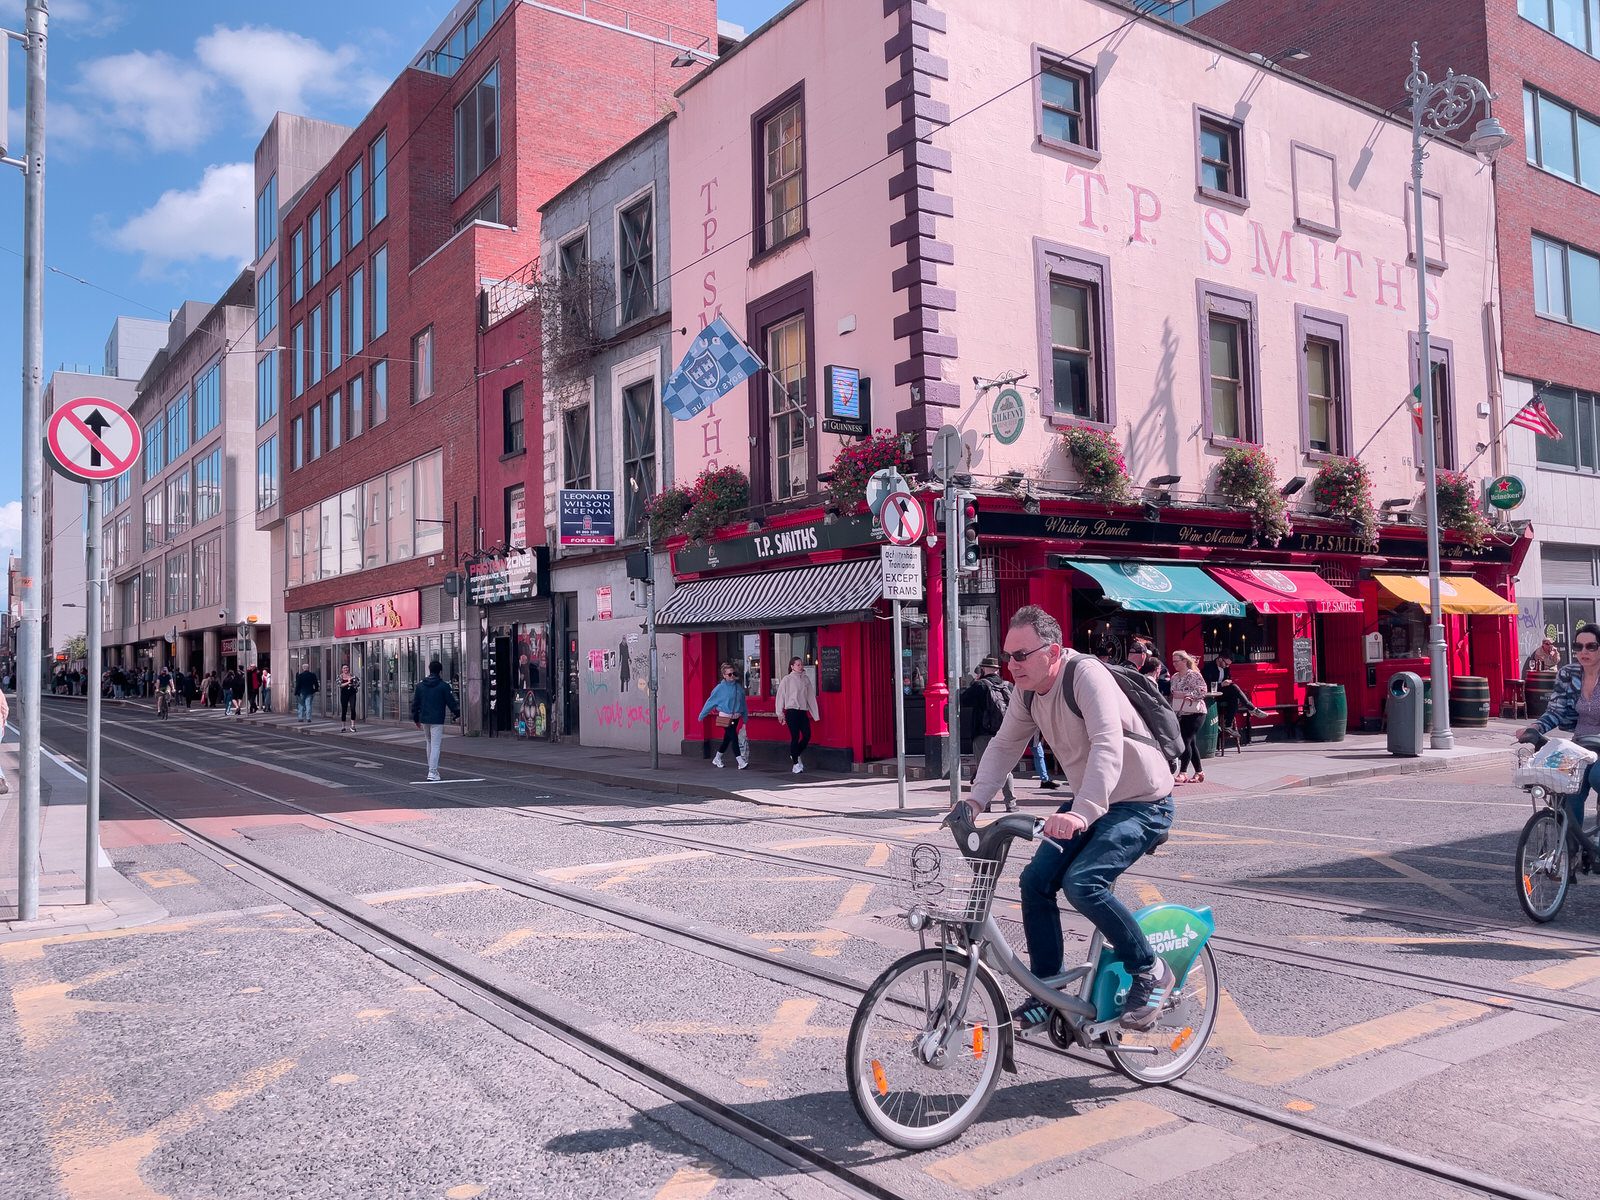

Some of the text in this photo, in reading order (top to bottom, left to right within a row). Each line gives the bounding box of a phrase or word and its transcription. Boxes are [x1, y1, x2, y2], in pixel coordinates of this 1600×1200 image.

[992, 408, 1024, 424] KILKENNY
[830, 421, 863, 433] GUINNESS
[1045, 517, 1088, 538] Whiskey
[1179, 526, 1203, 542] Wine
[1205, 528, 1248, 544] Merchant
[775, 527, 818, 555] SMITHS
[885, 573, 919, 583] EXCEPT
[887, 586, 918, 596] TRAMS
[345, 605, 372, 631] INSOMNIA
